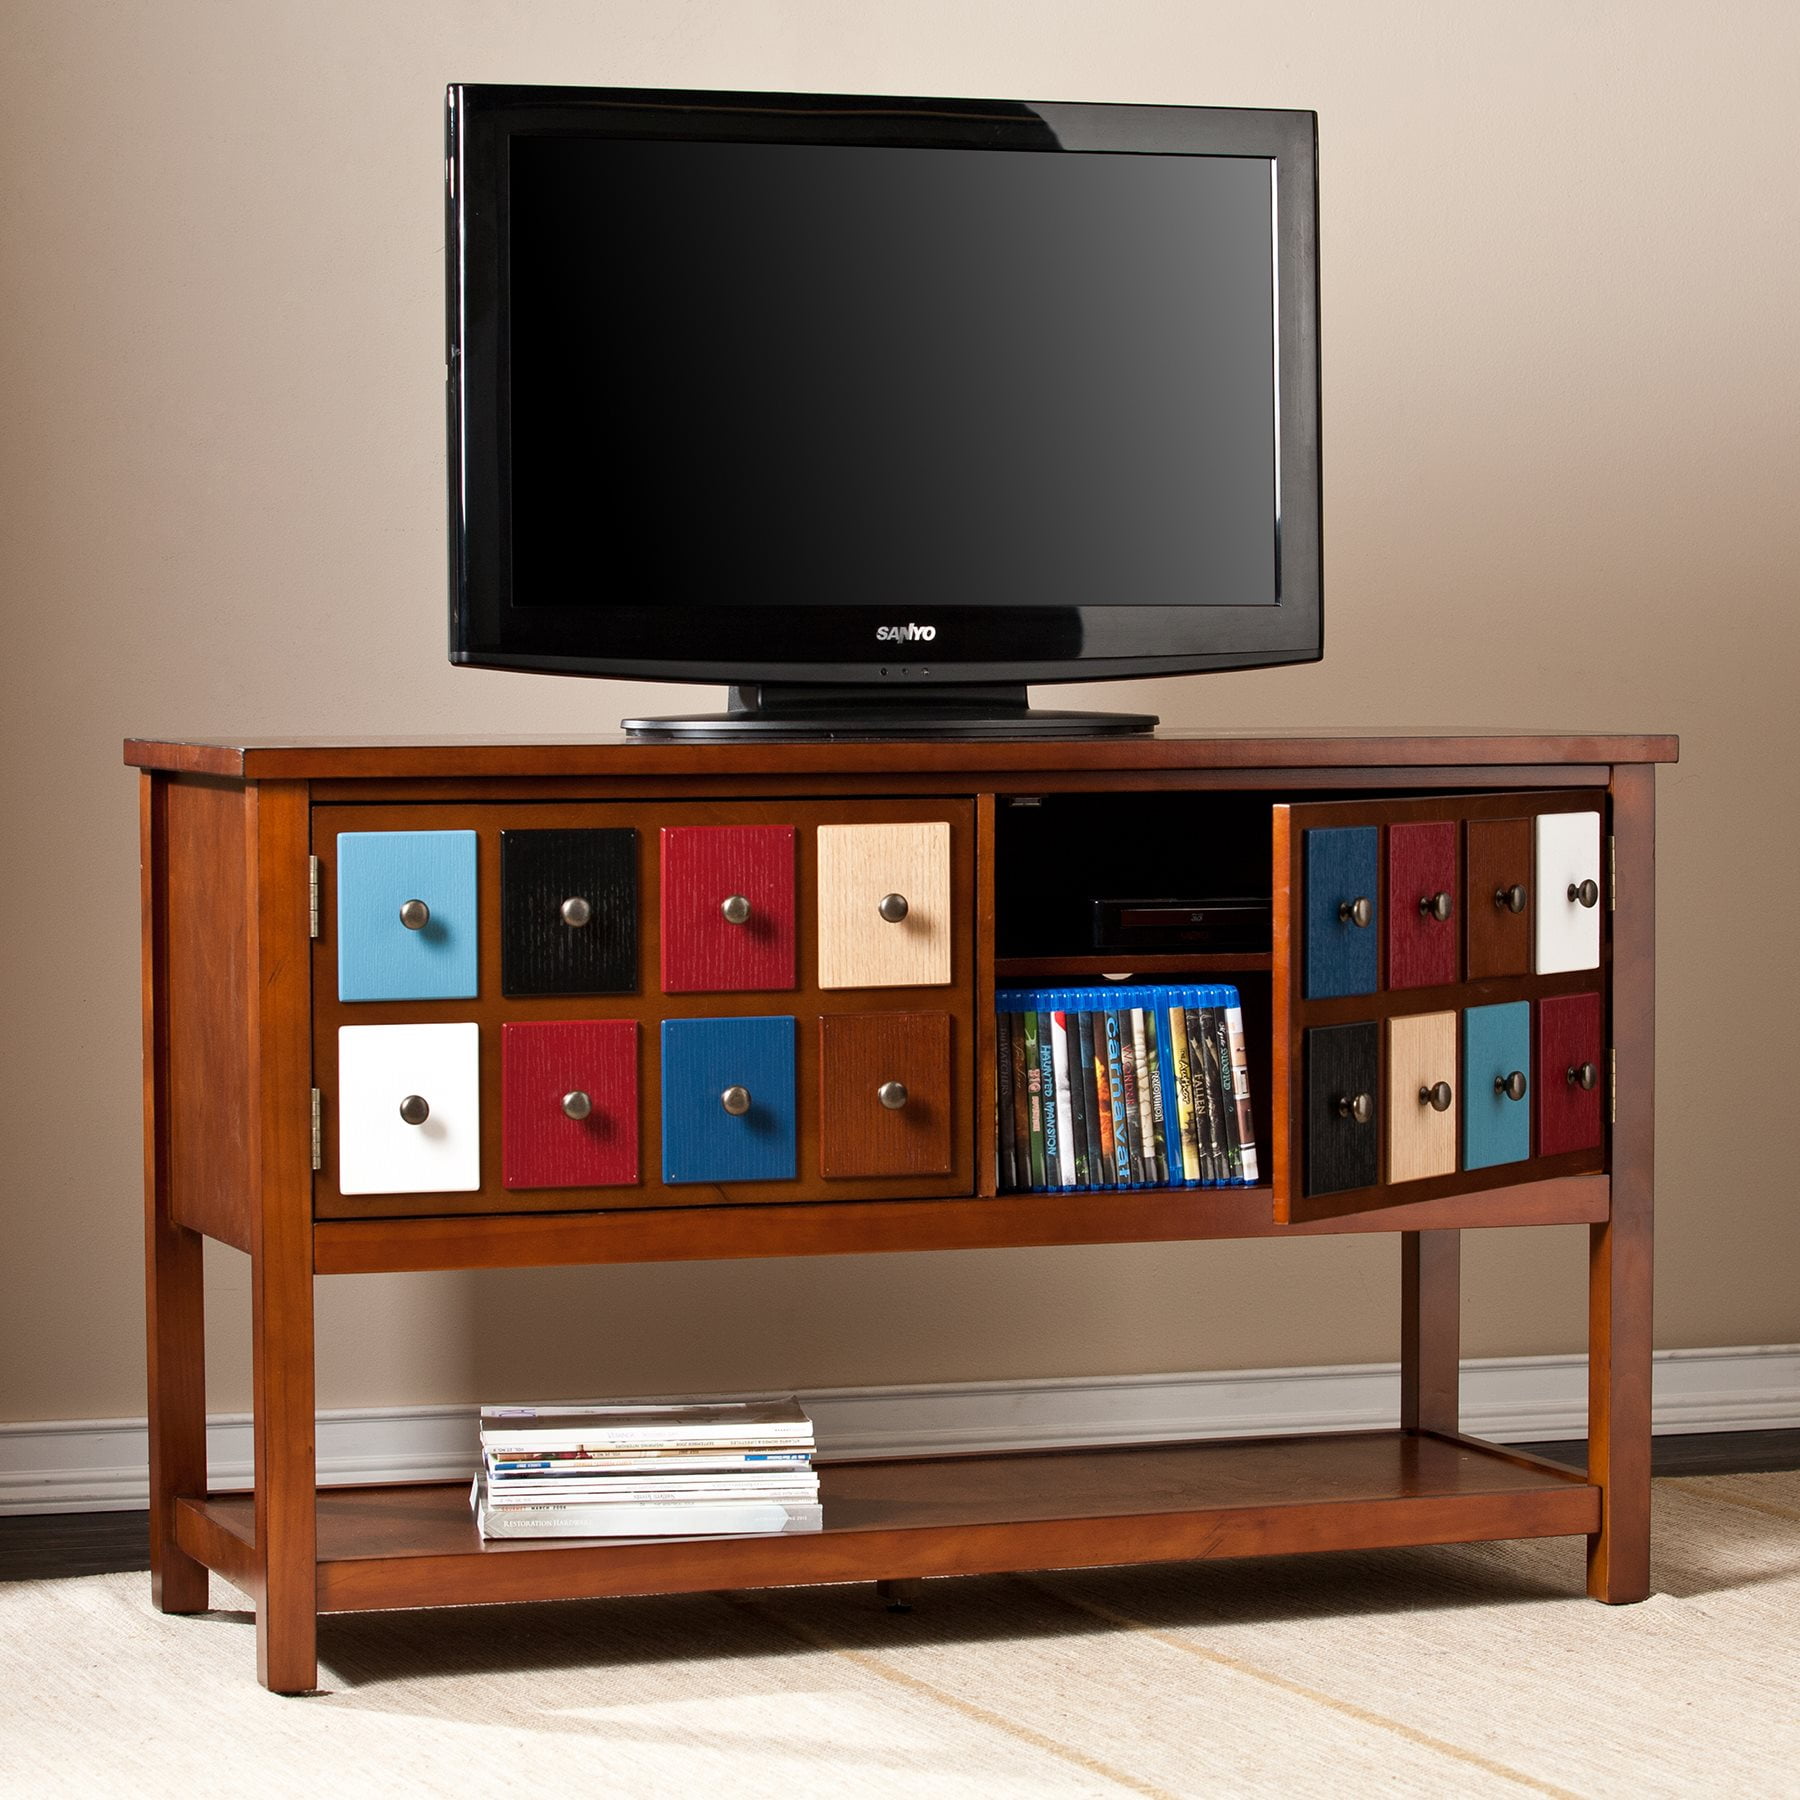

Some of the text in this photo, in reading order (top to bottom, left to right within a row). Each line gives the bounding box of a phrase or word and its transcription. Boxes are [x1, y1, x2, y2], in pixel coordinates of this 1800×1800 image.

[876, 622, 936, 644] SANYO
[1027, 1068, 1041, 1093] BIG
[1178, 1060, 1192, 1105] Author
[1194, 1073, 1206, 1115] FALLEN
[1040, 1044, 1057, 1156] HAUNTED MANSION
[503, 1519, 553, 1528] RESTORATION
